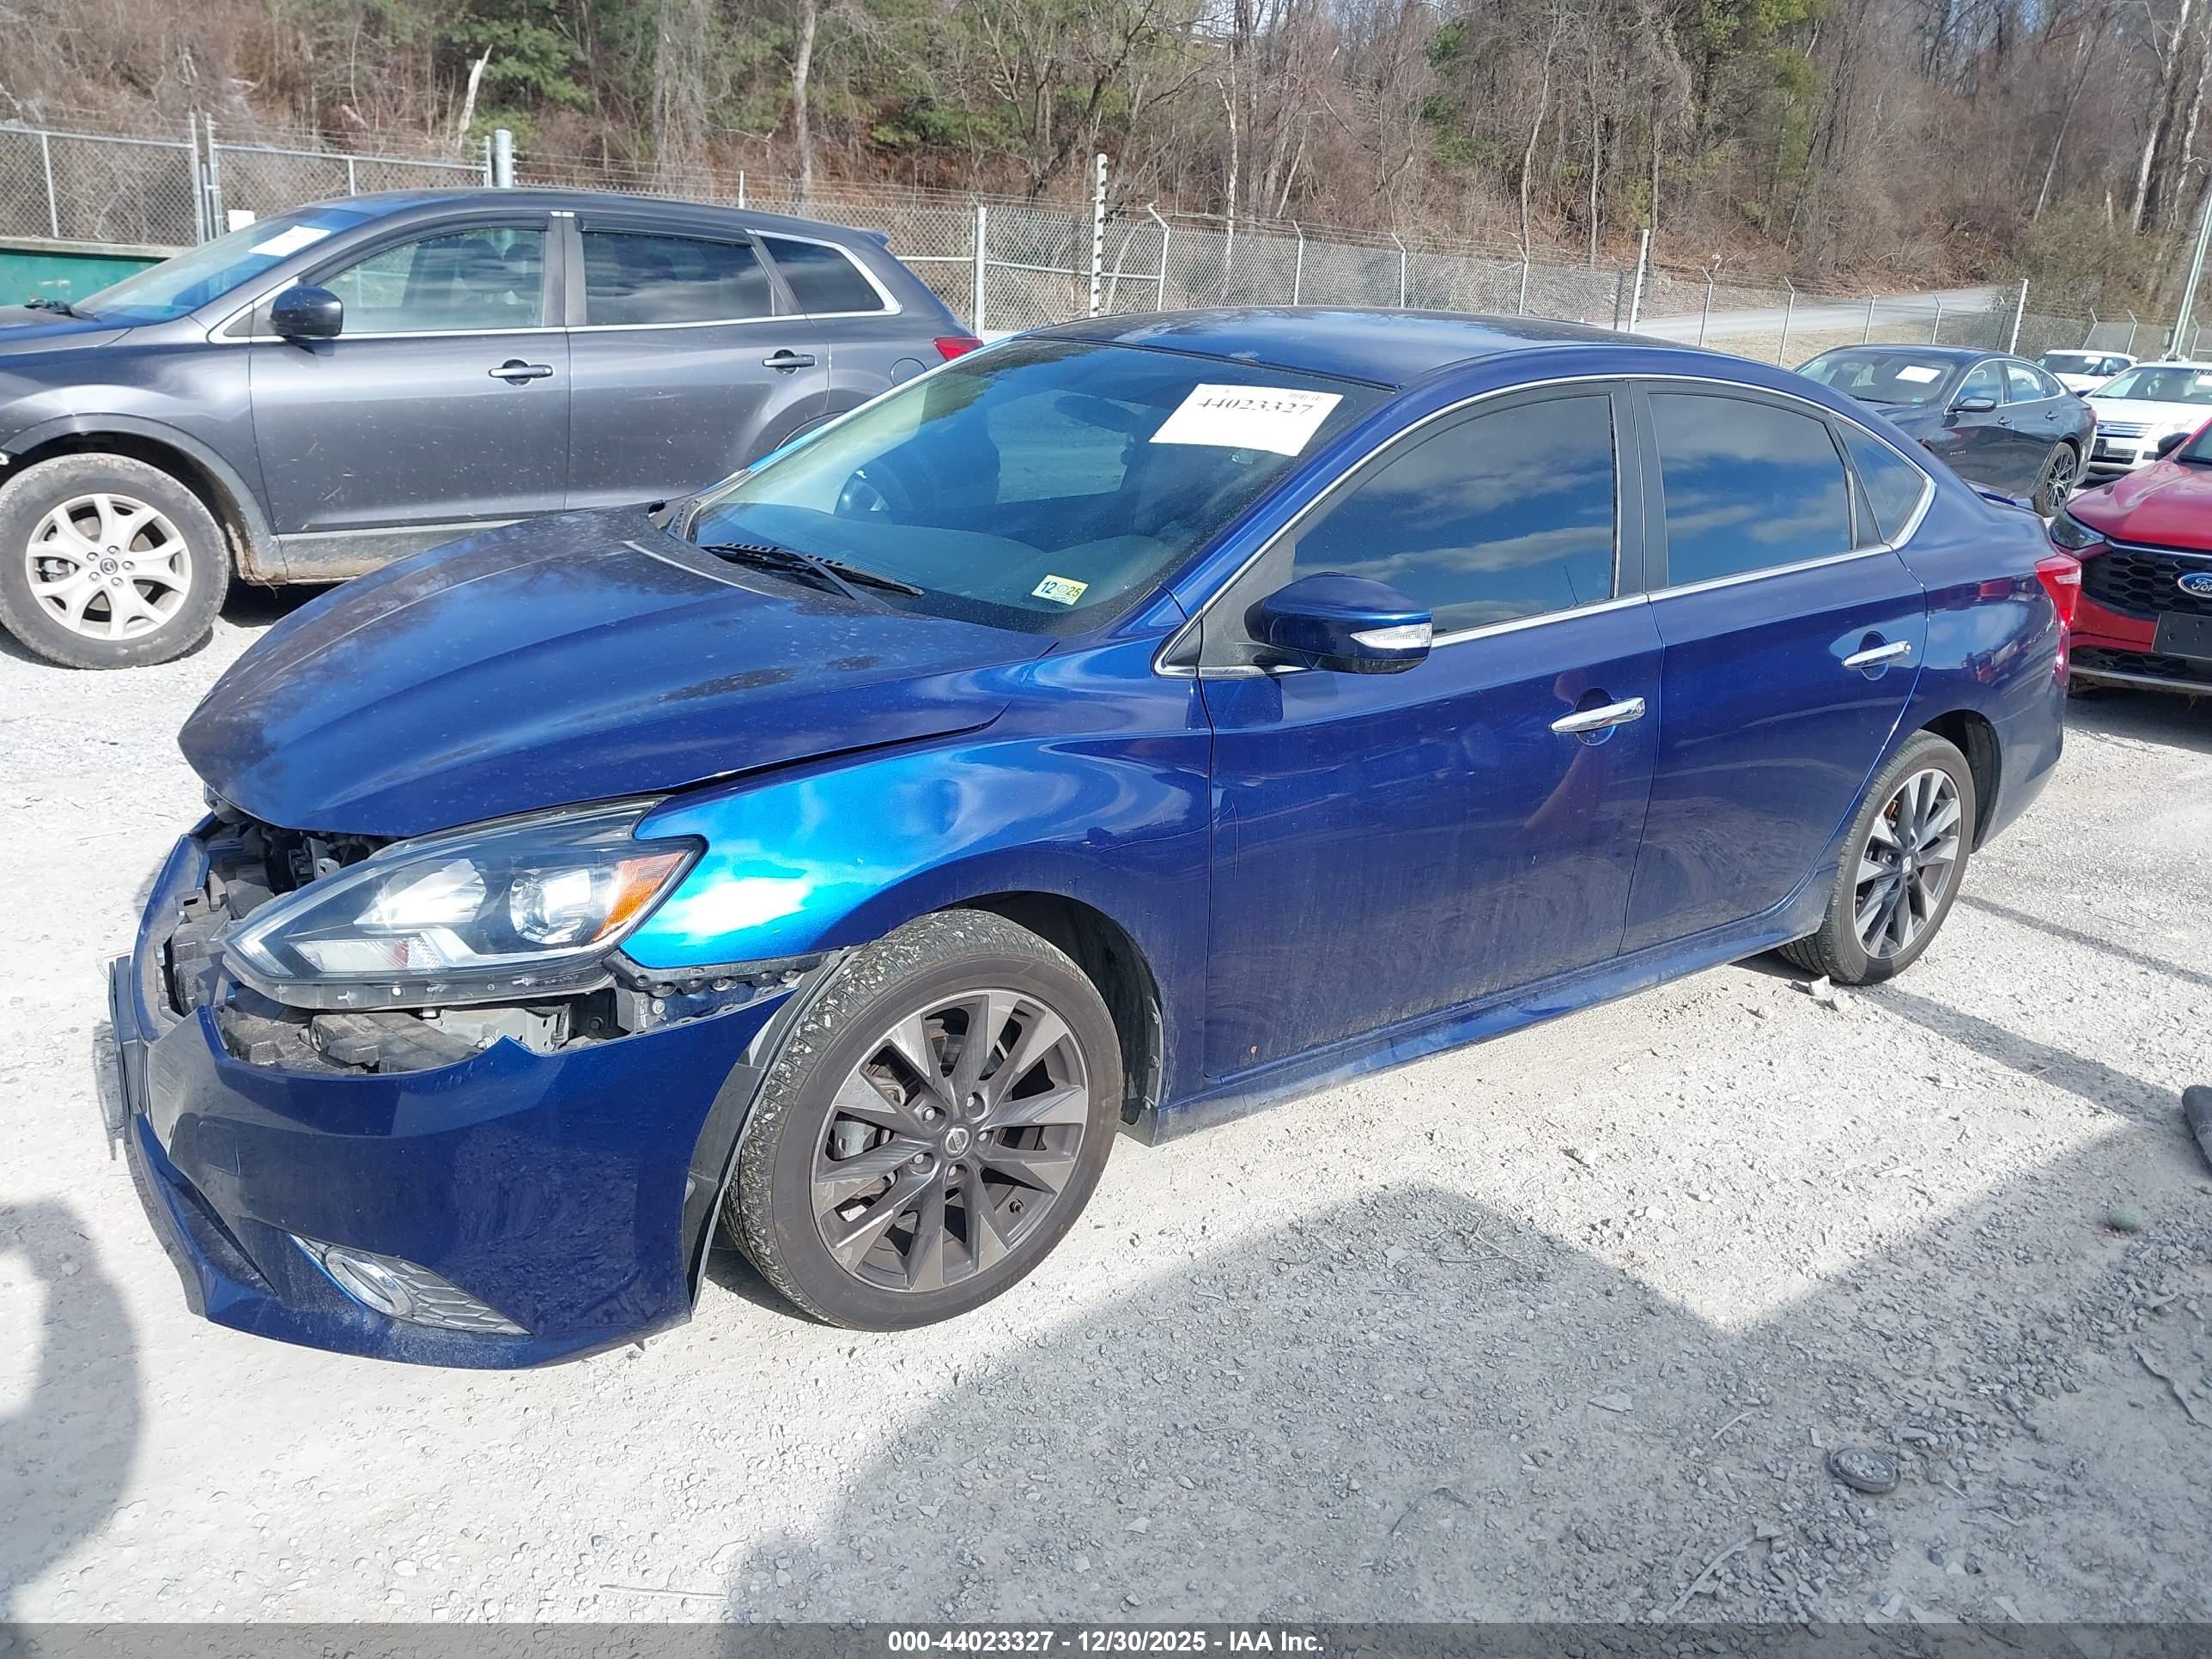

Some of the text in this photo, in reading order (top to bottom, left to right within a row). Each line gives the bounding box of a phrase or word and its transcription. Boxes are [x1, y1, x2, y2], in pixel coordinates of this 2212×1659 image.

[1197, 397, 1314, 415] 44023327
[1041, 580, 1082, 598] 12 25
[2191, 577, 2212, 592] For
